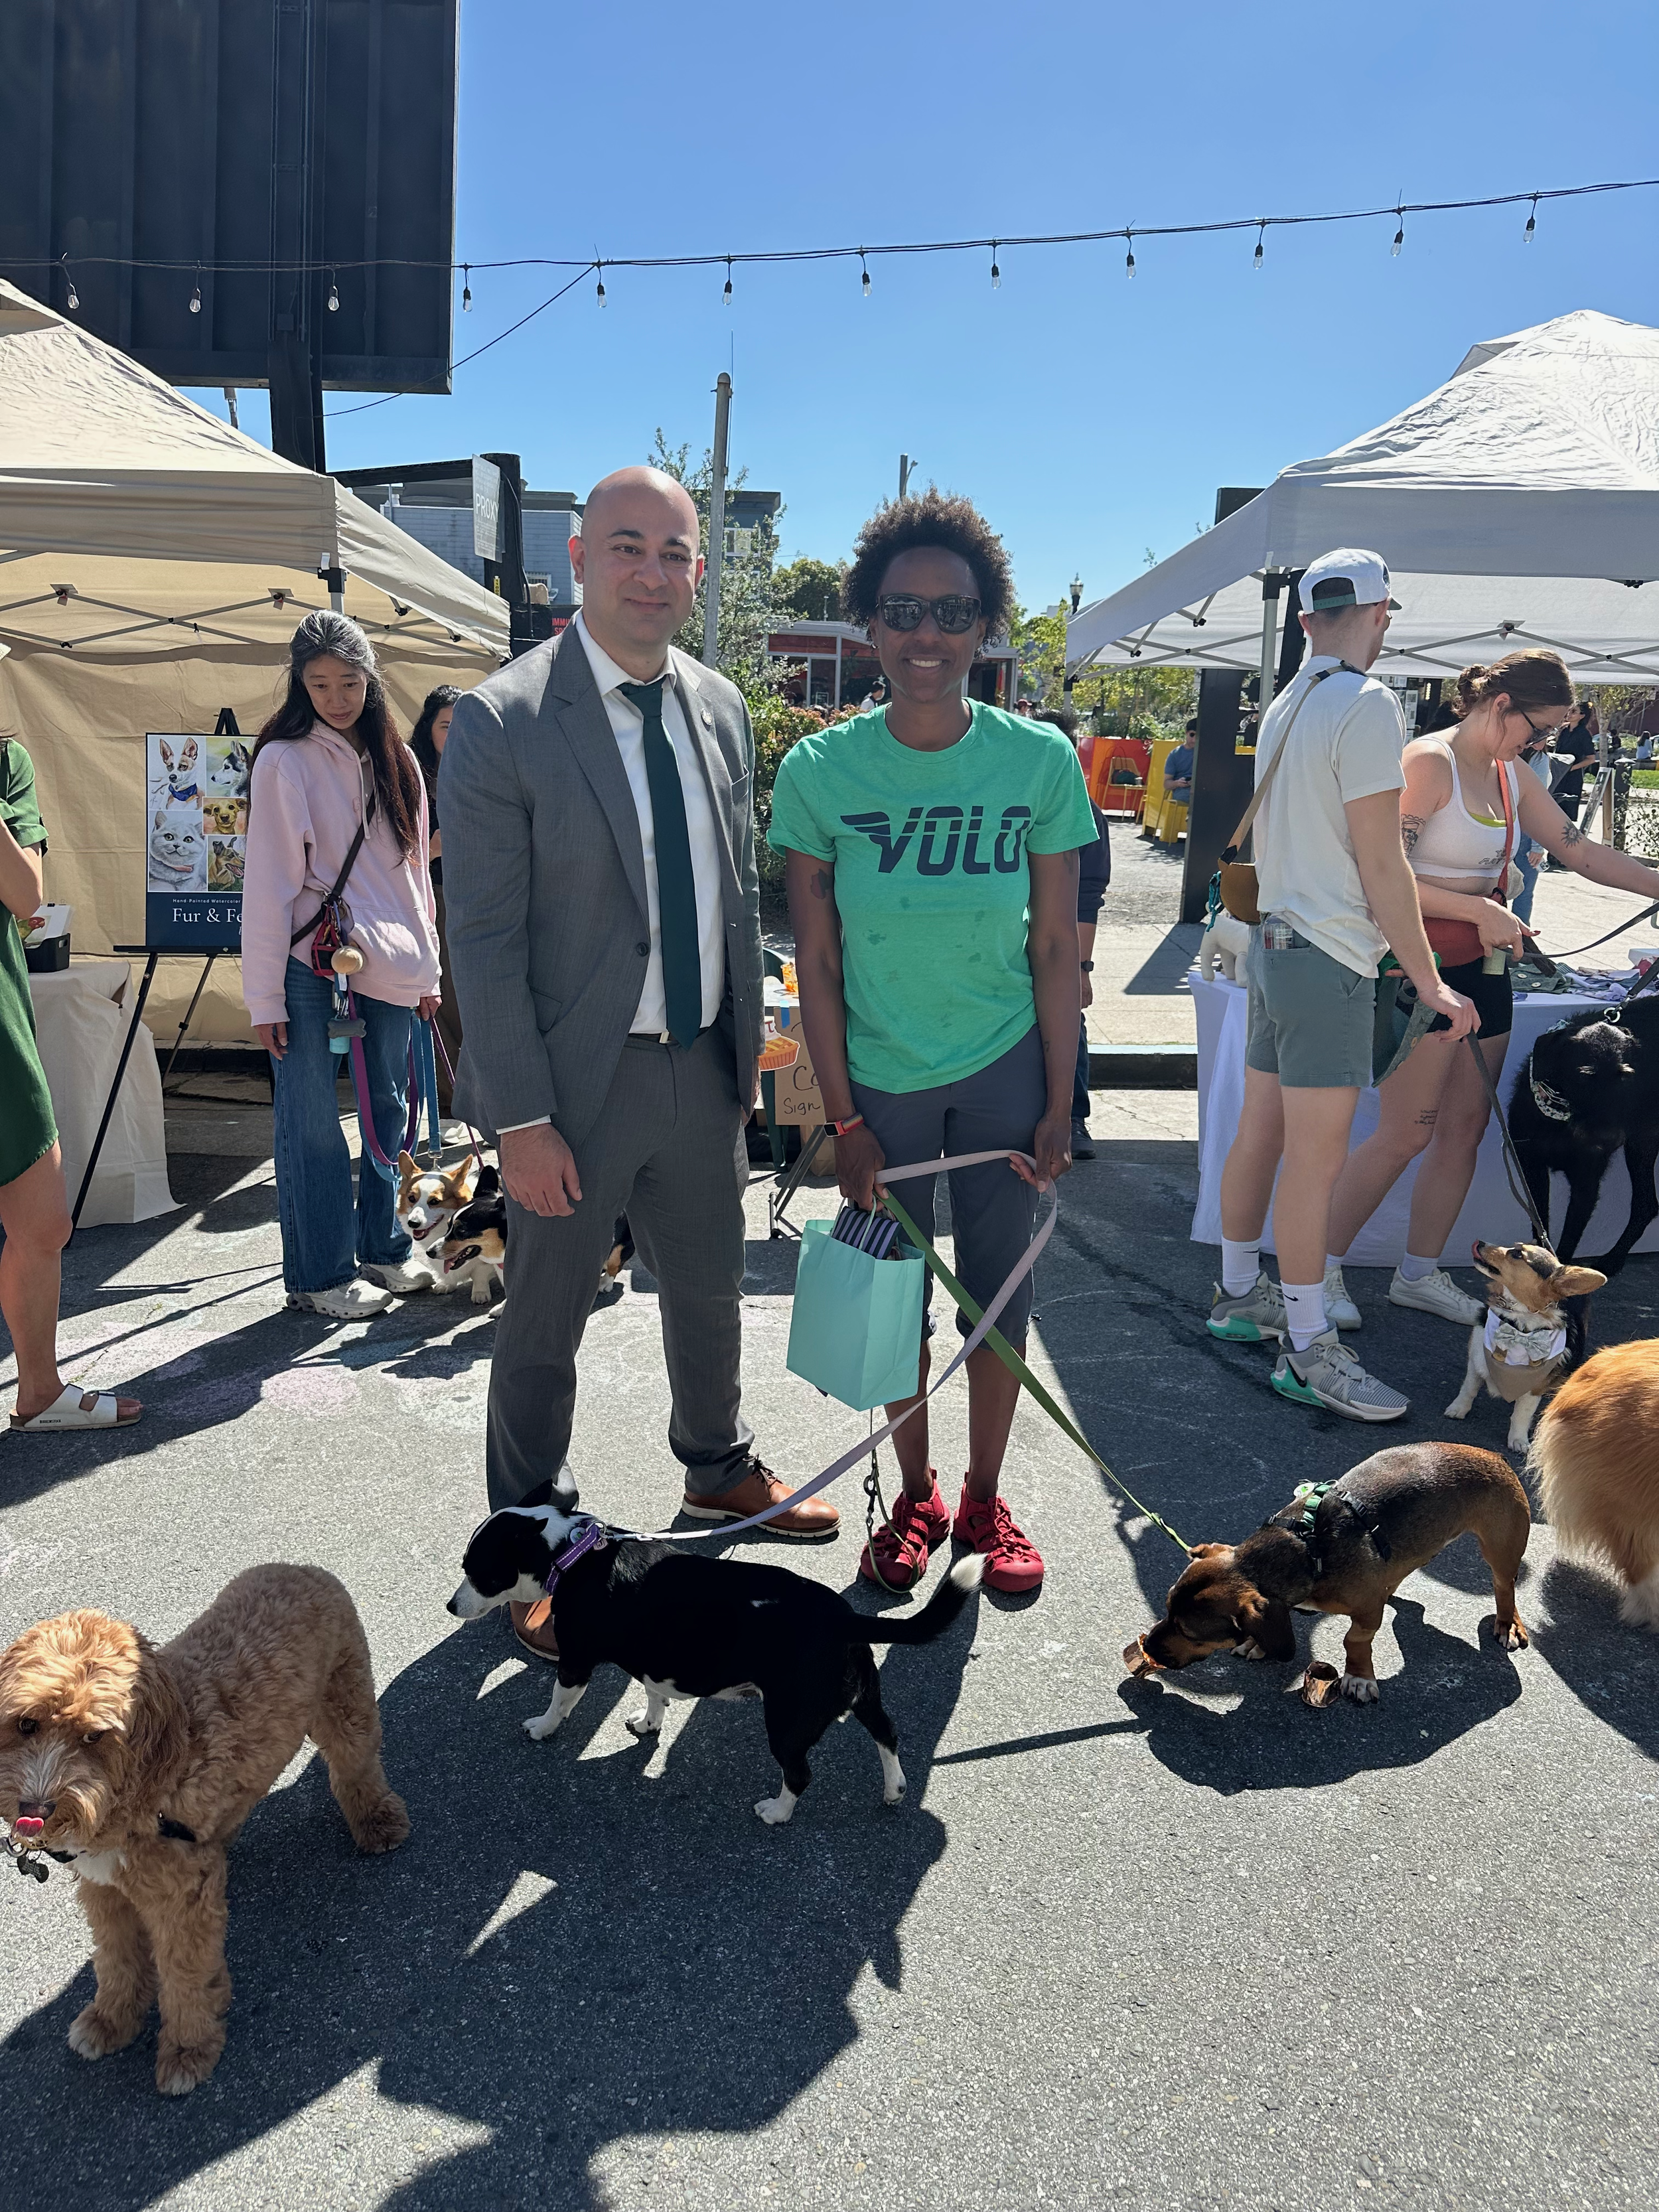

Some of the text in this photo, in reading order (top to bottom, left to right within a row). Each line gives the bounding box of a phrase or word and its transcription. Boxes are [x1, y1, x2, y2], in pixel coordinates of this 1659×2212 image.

[476, 493, 499, 522] PROXY
[840, 806, 1032, 876] VOLO
[173, 908, 201, 922] Fur
[206, 908, 221, 922] &
[783, 1097, 821, 1116] Sign
